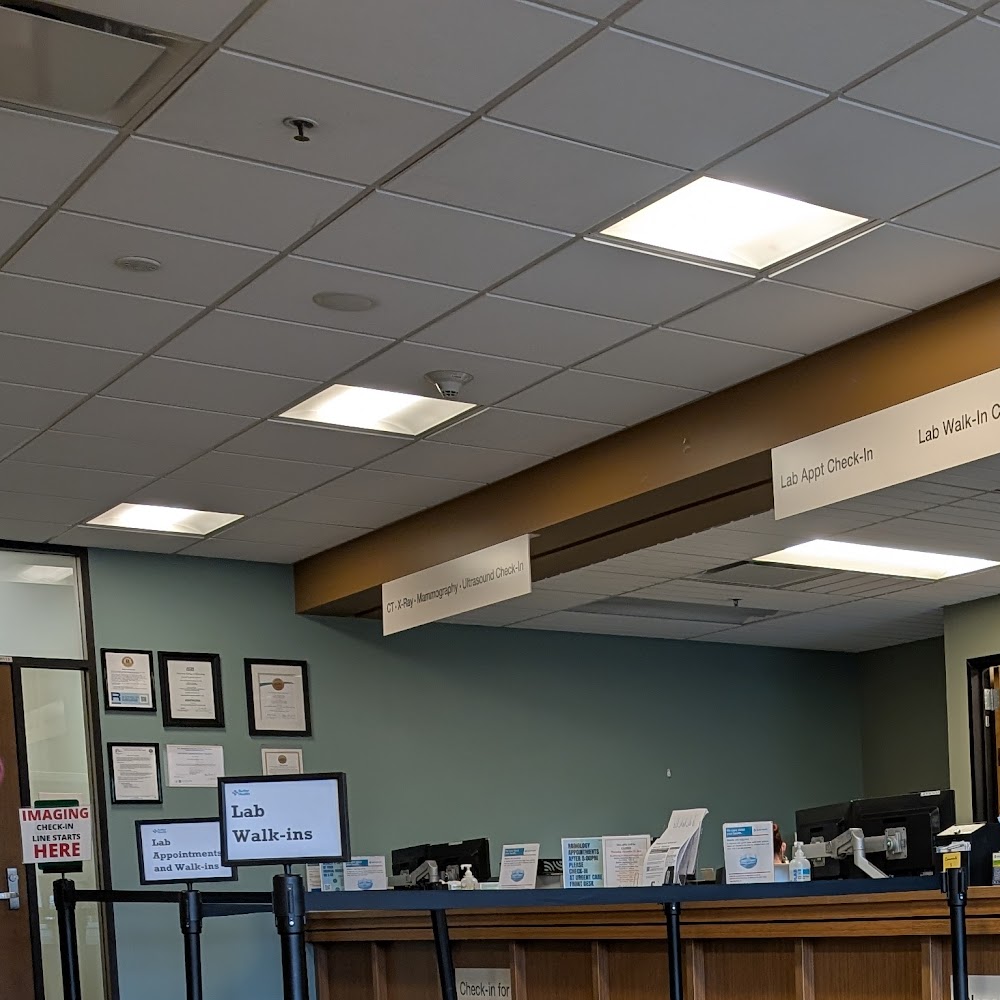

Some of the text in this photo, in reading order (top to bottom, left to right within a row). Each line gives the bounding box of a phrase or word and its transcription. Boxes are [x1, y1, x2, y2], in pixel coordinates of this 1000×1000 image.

[918, 424, 940, 444] Lab
[943, 409, 988, 435] Walk-In
[780, 447, 874, 489] Lab Appt Check-In
[417, 582, 458, 602] Mammography
[462, 569, 495, 590] Ultrasound
[495, 561, 524, 579] Check-In
[22, 807, 89, 821] IMAGING
[231, 804, 265, 819] Lab
[36, 823, 74, 831] CHECK-IN
[52, 833, 81, 841] STARTS
[152, 838, 171, 847] Lab
[232, 827, 313, 843] Walk-ins
[34, 842, 81, 859] HERE
[152, 850, 222, 861] Appointments
[154, 862, 219, 872] and Walk-ins
[460, 981, 510, 997] Check-in for
